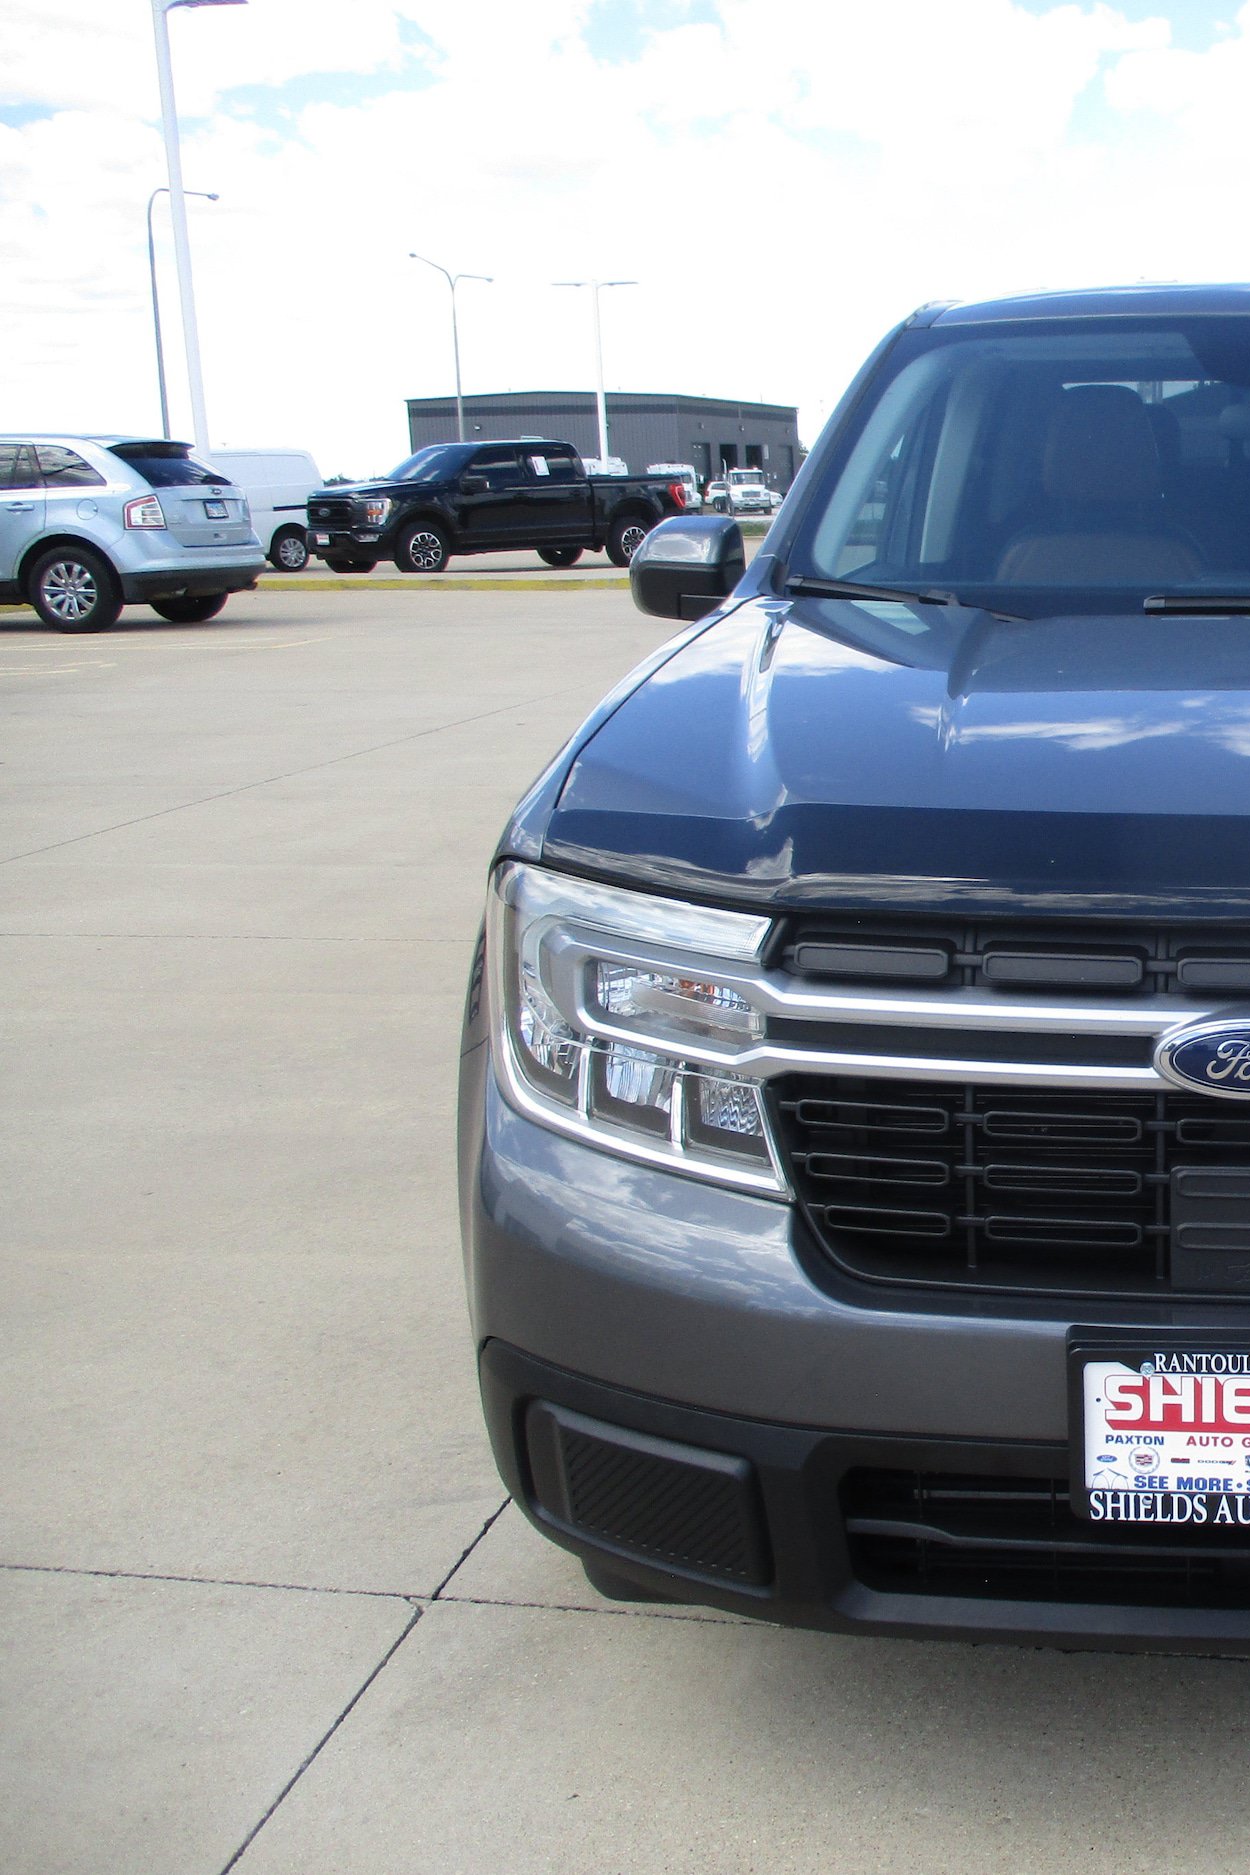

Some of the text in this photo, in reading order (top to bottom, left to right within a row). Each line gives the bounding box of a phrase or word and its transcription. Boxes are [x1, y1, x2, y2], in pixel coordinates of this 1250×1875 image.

[1105, 1434, 1165, 1446] PAXTON
[1186, 1435, 1234, 1448] AUTO
[1134, 1475, 1169, 1490] SEE
[1176, 1476, 1233, 1492] MORE
[1089, 1491, 1208, 1524] SHIELDS
